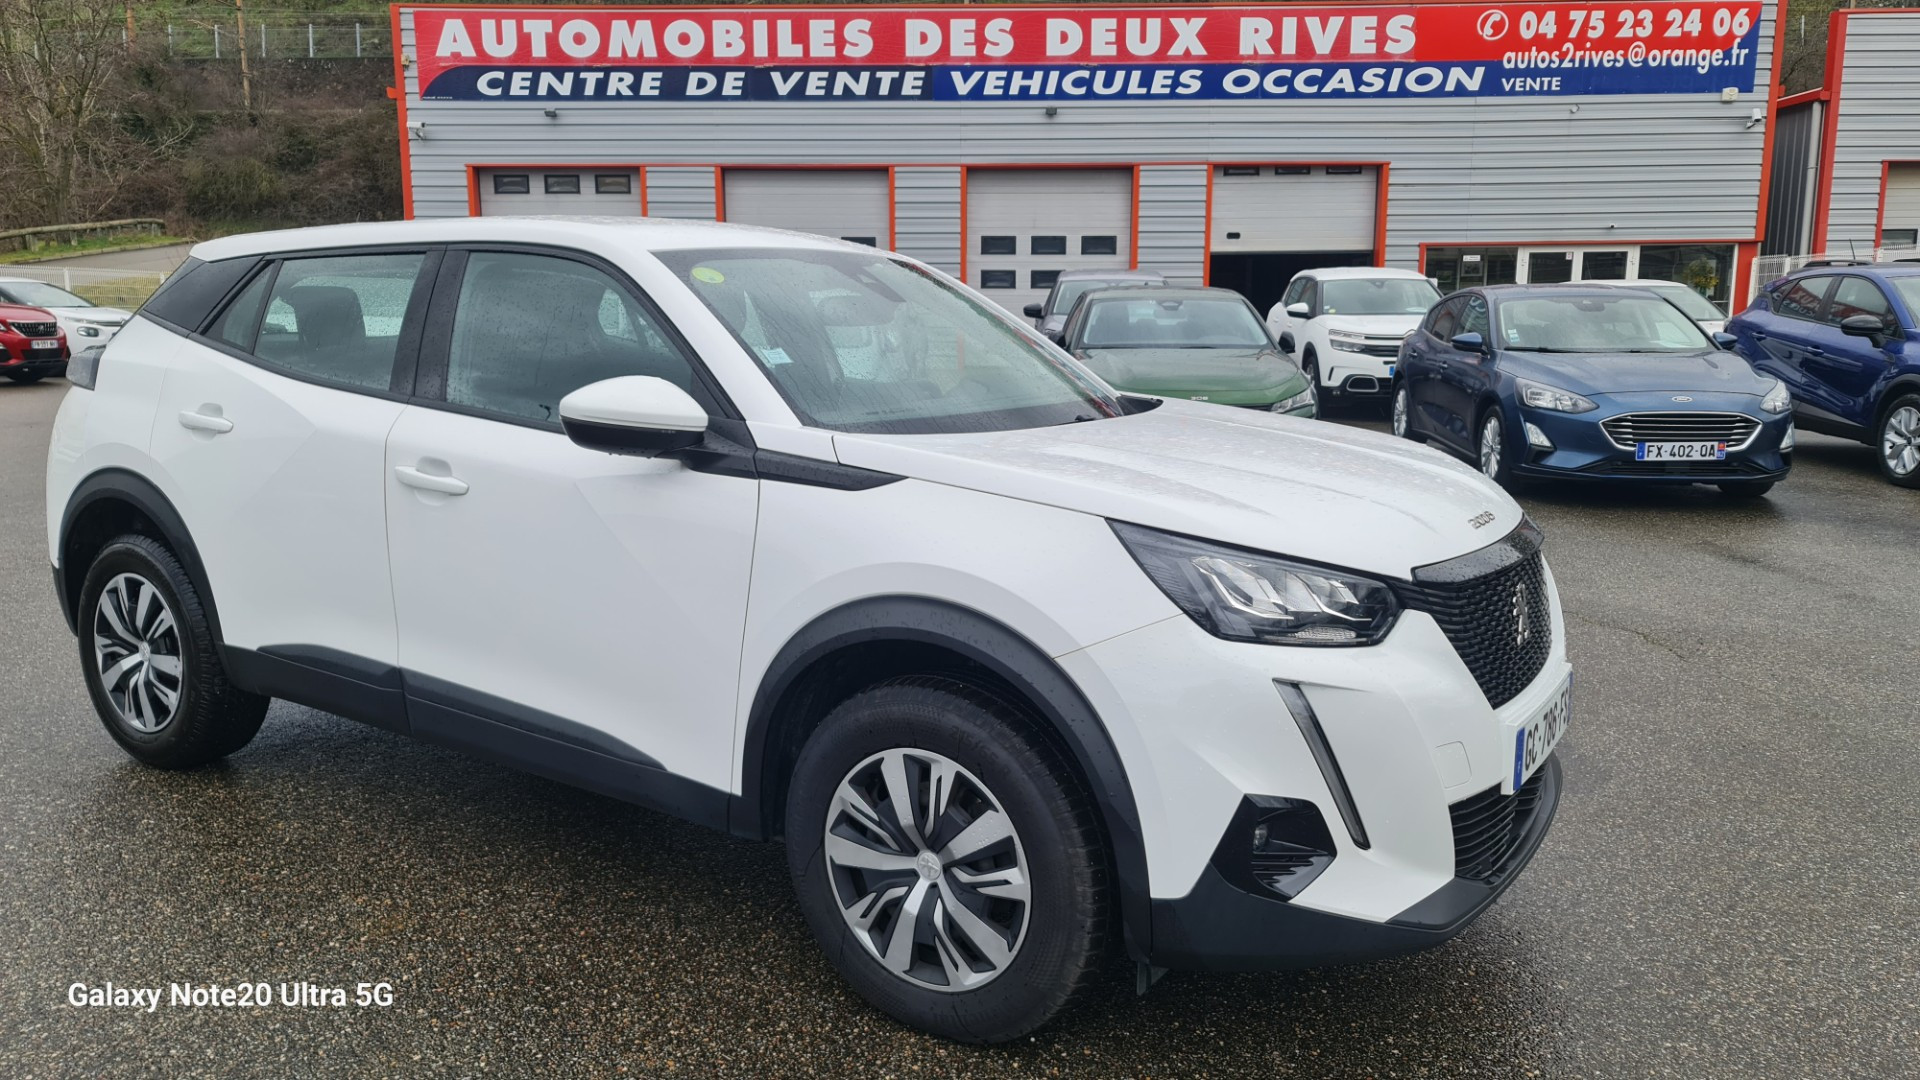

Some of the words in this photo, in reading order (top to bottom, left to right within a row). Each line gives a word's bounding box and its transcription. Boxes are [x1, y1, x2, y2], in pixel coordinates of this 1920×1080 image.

[436, 18, 874, 59] AUTOMOBILES
[905, 18, 1015, 58] DES
[1045, 17, 1208, 57] DEUX
[1239, 14, 1418, 56] RIVES
[1518, 10, 1557, 39] 04
[1567, 10, 1606, 39] 75
[1614, 9, 1653, 38] 23
[1663, 8, 1702, 37] 24
[1712, 8, 1750, 36] 06
[1502, 38, 1750, 74] autos2rives@orange.fr
[475, 70, 663, 96] CENTRE
[685, 71, 746, 96] DE
[768, 70, 926, 97] VENTE
[950, 70, 1203, 96] VEHICULES
[1222, 66, 1486, 94] OCCASION
[1501, 77, 1561, 92] VENTE
